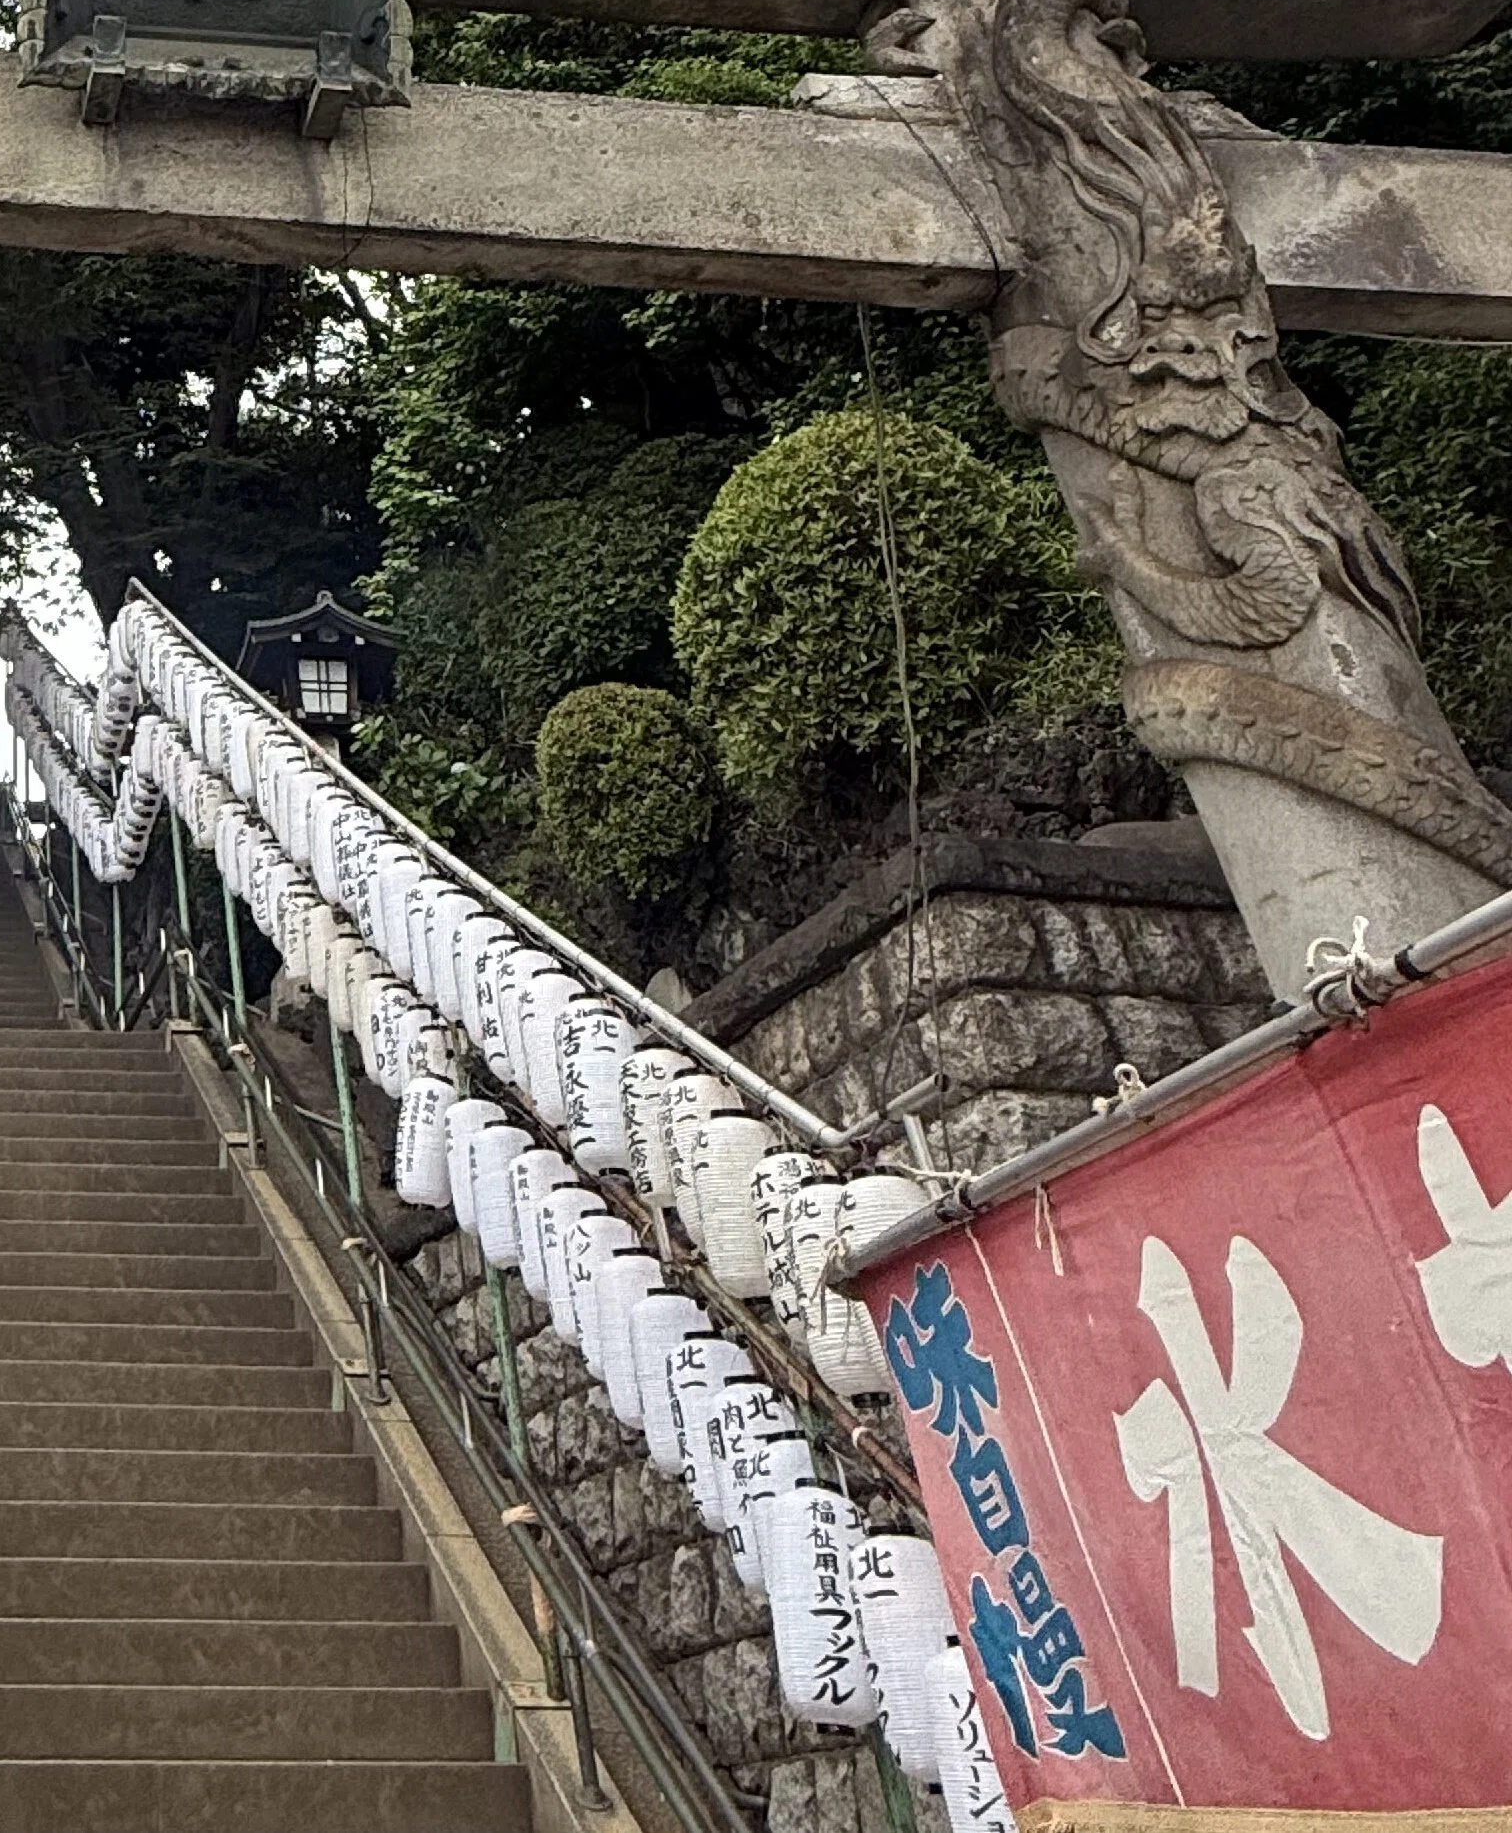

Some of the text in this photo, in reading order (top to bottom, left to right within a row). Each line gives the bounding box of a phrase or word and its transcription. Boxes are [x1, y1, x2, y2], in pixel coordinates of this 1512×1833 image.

[590, 1019, 619, 1053] 北一
[674, 1085, 698, 1124] 北一
[794, 1197, 822, 1244] 北一
[676, 1344, 708, 1389] 北一
[749, 1450, 776, 1501] 北一
[885, 1258, 1128, 1763] 味自慢
[857, 1546, 900, 1599] 北一
[806, 1498, 856, 1706] 福祉用具フックル
